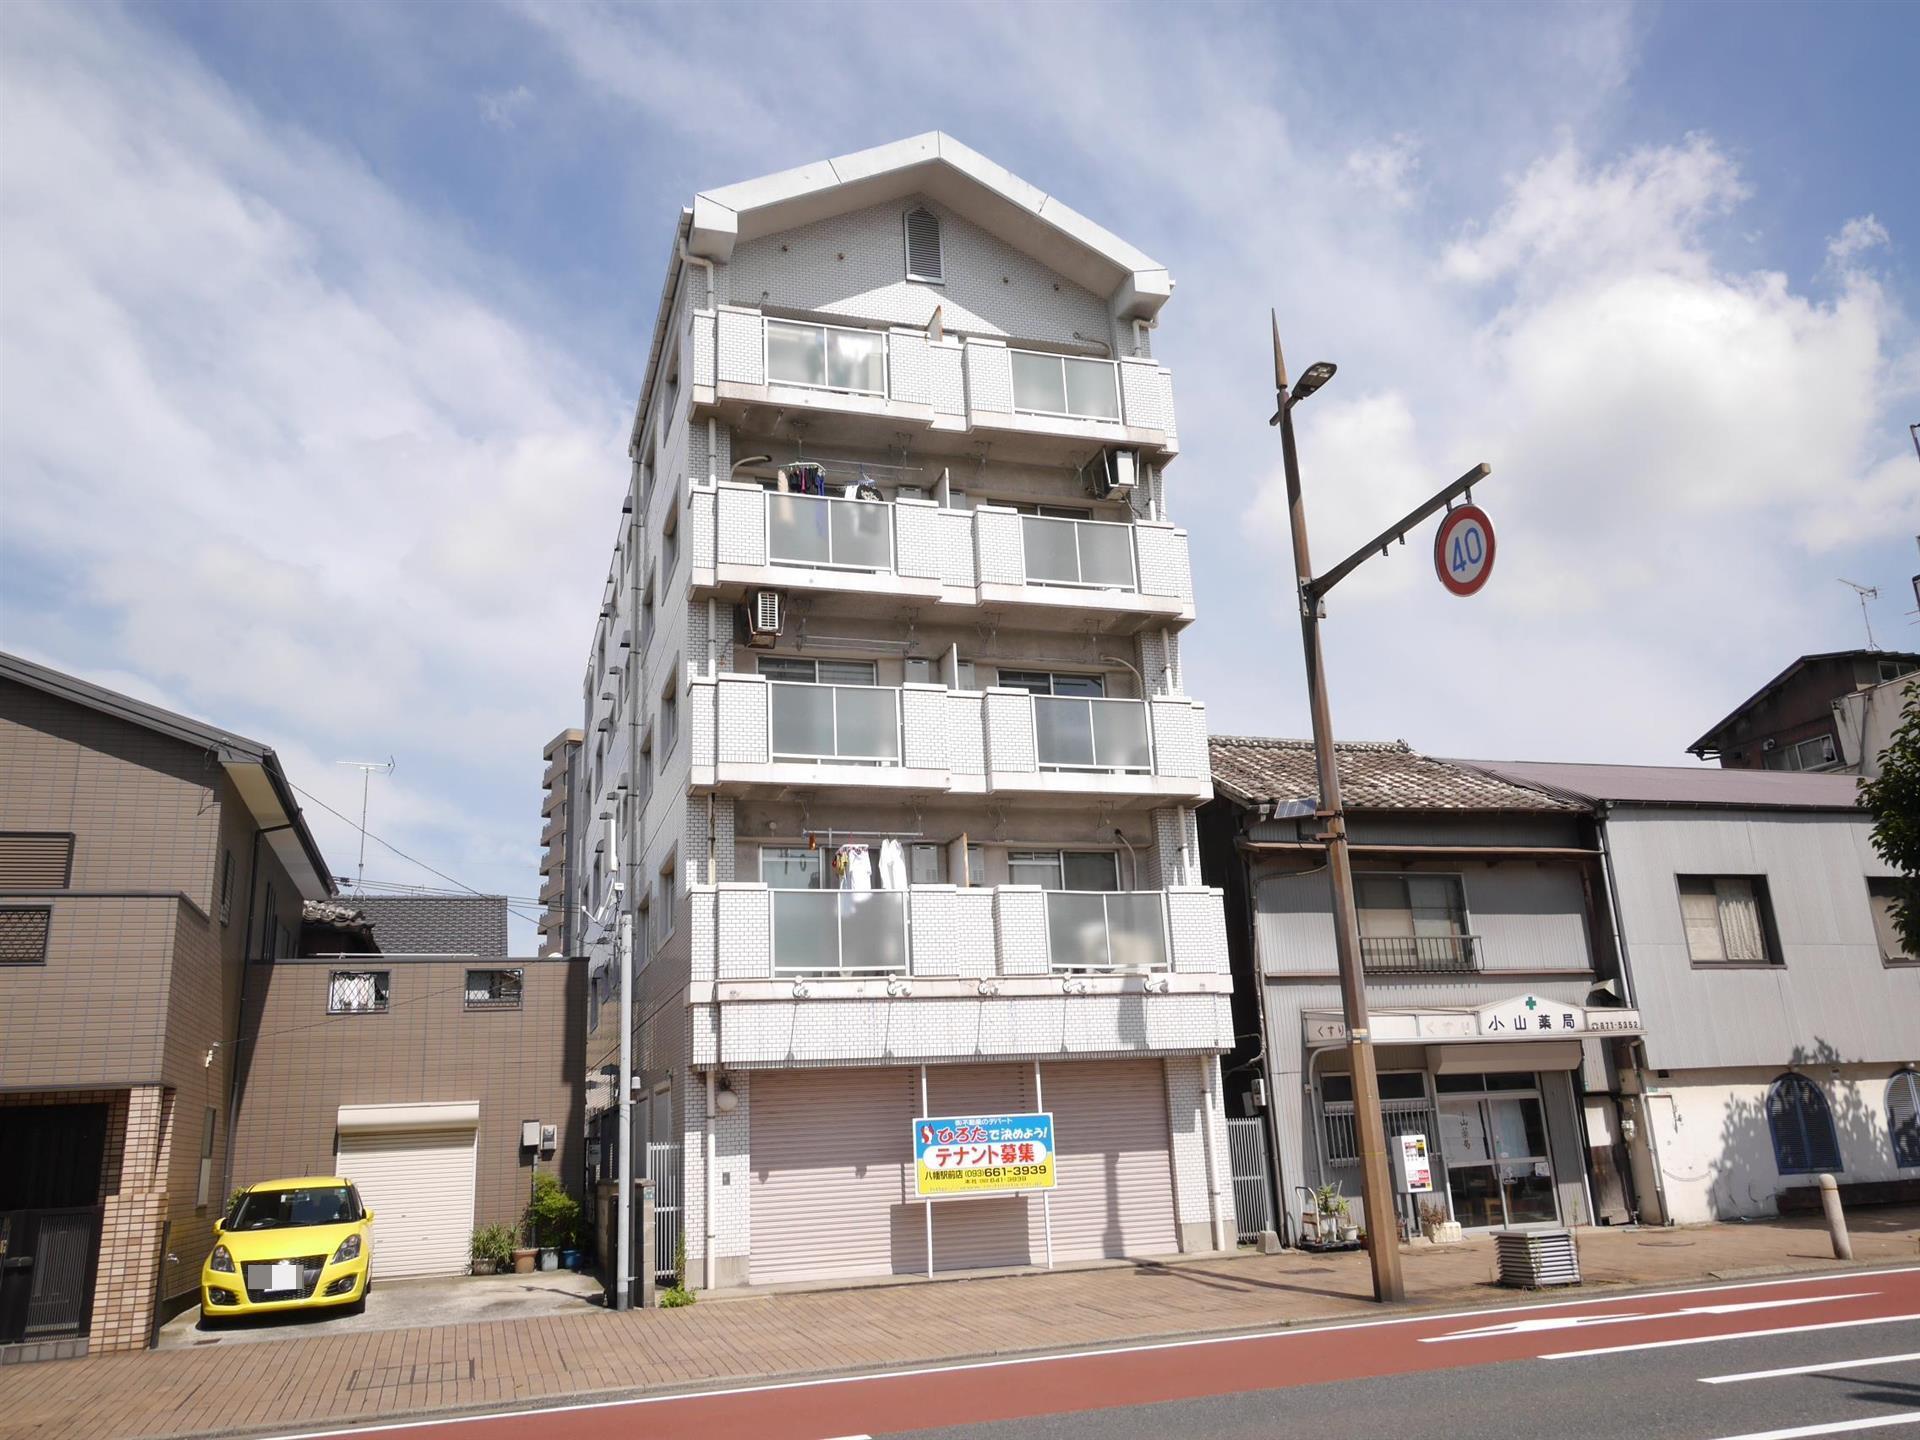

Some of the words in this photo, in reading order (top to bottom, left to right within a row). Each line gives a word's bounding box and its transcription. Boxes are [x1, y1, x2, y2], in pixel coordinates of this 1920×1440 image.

[1453, 527, 1482, 571] 40
[1488, 1013, 1575, 1030] 小山薬局
[936, 1143, 1035, 1167] テナント募集
